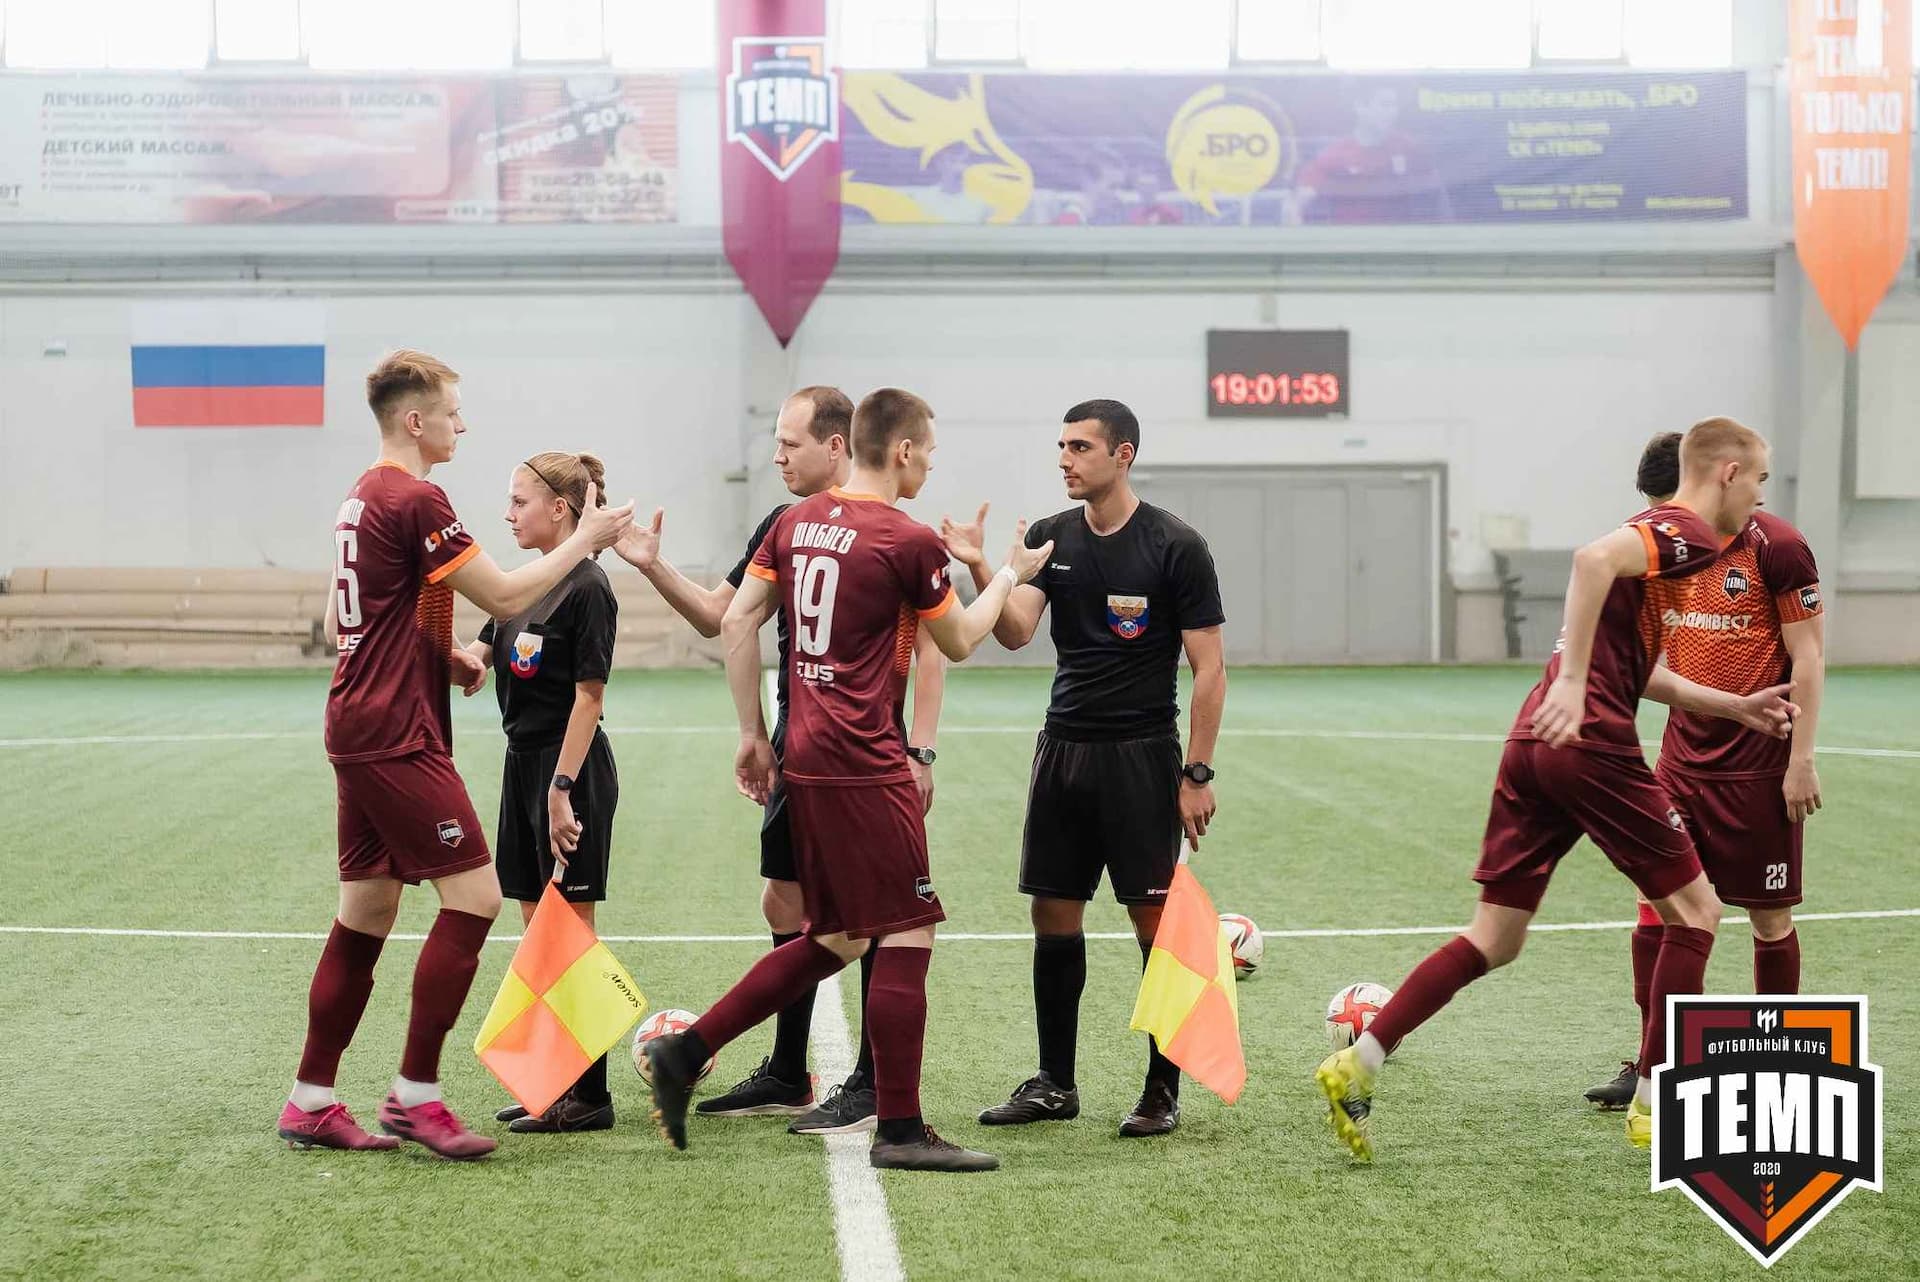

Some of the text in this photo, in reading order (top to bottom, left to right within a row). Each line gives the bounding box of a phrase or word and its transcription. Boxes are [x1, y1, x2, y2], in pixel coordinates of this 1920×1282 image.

[737, 77, 827, 126] ТЕМП
[1803, 91, 1904, 134] ТОЛЬКО
[42, 138, 134, 154] ДЕТСКИЙ
[482, 124, 578, 164] СКИДКА
[1816, 148, 1889, 190] ТЕМП!
[1211, 373, 1340, 405] 19:01:53
[791, 522, 857, 554] ШИБАЕВ
[792, 555, 840, 656] 19
[1765, 863, 1788, 890] 23
